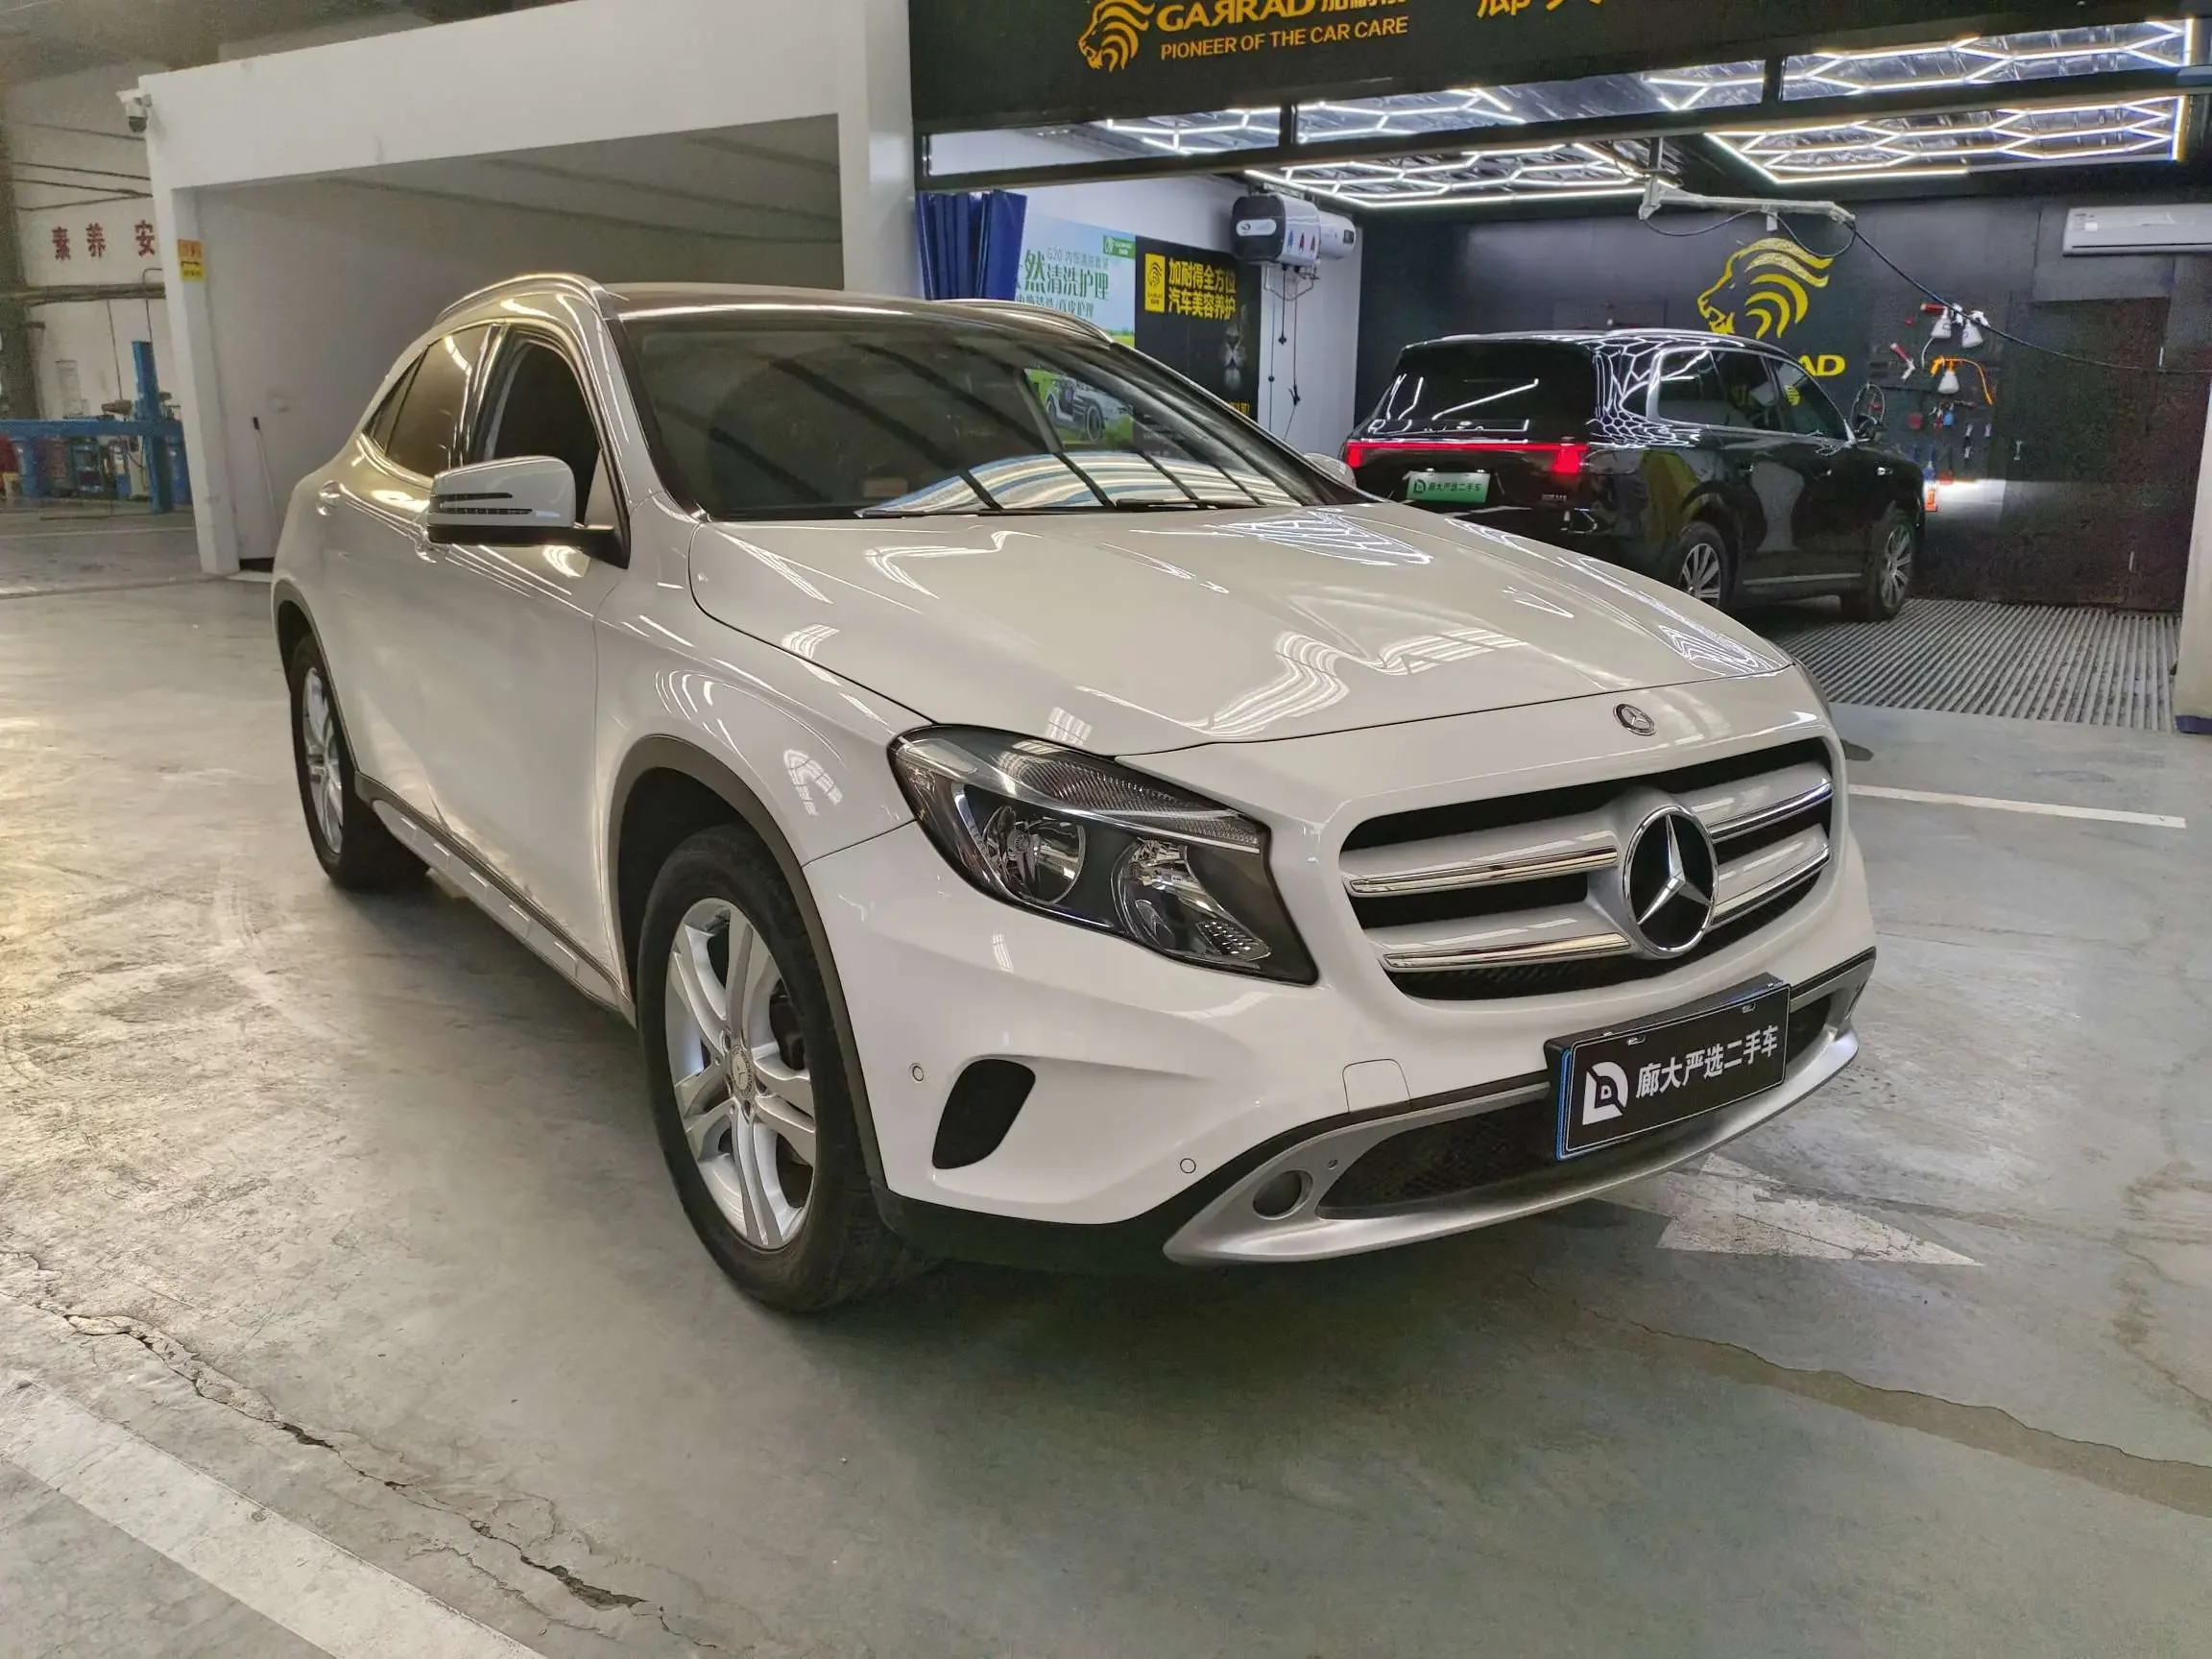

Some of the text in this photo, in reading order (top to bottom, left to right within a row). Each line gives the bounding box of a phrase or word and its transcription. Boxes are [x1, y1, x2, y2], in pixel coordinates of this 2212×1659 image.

[1161, 15, 1410, 60] PIONEER OF THE CAR CARE
[1015, 249, 1109, 300] 然清洗护理
[1168, 257, 1237, 294] 加耐得全方位
[1167, 286, 1237, 320] 汽车美容养护
[1635, 1024, 1778, 1098] 廊大严选二手车
